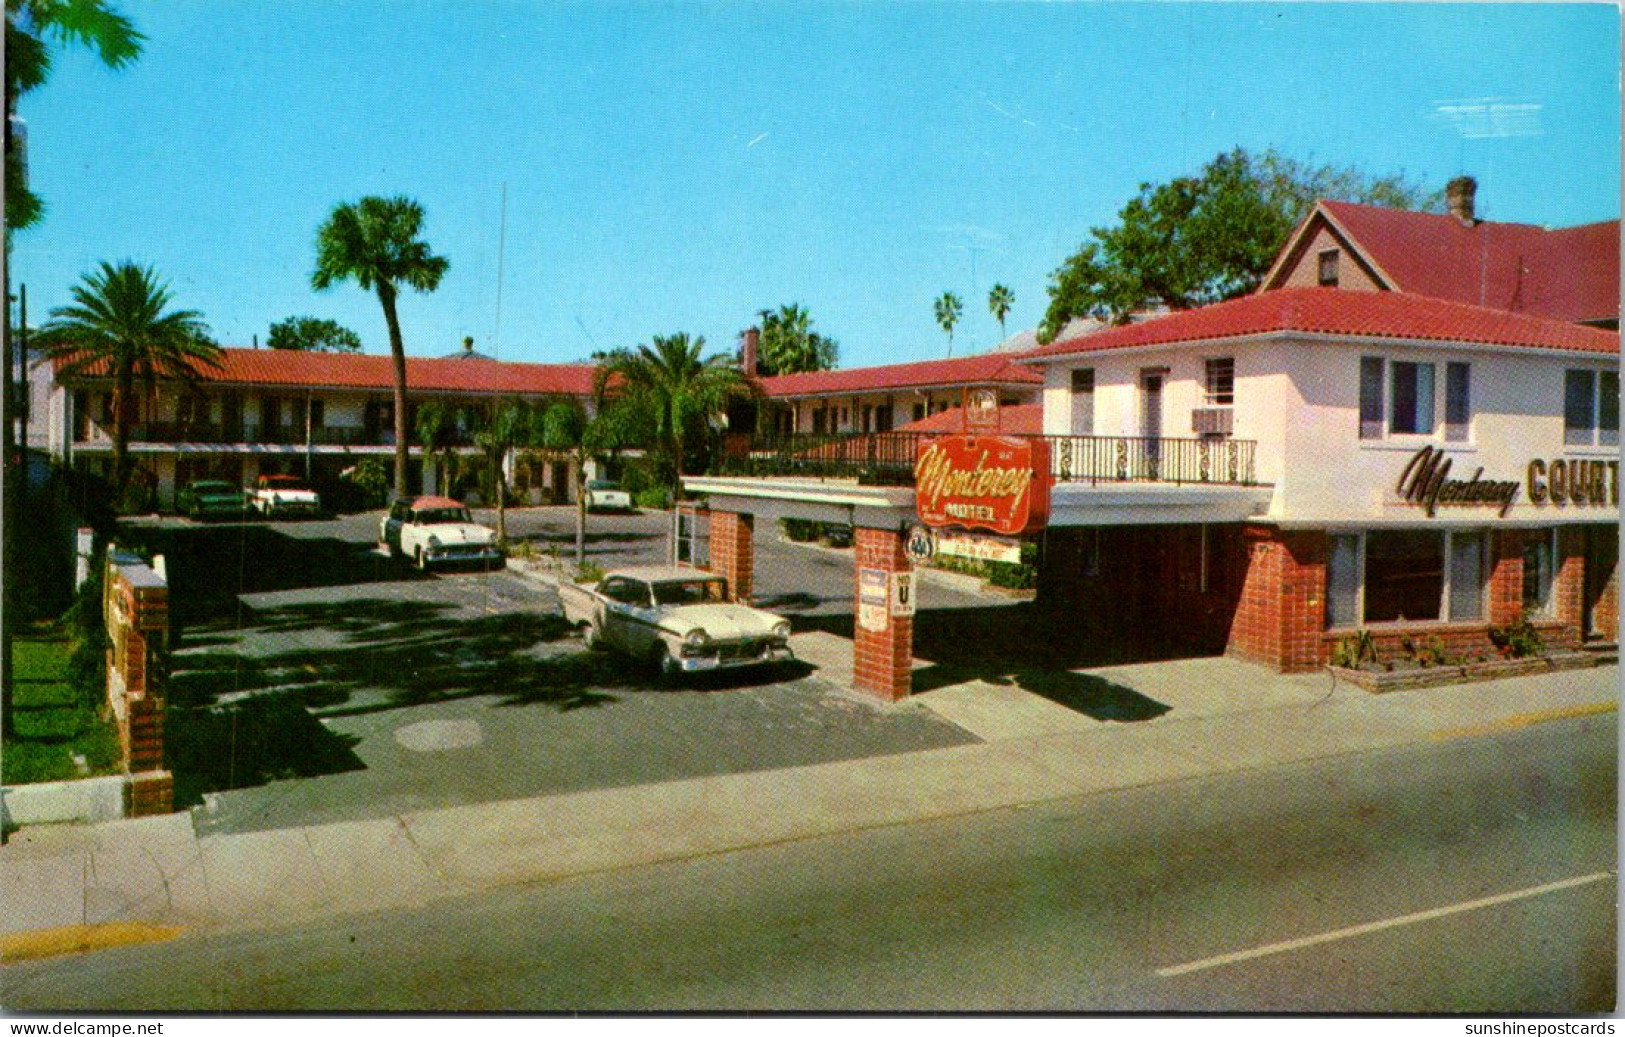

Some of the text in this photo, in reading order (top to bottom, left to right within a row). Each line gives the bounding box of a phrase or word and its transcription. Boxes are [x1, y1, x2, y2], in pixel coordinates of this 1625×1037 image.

[914, 443, 1033, 518] Monterey
[1395, 444, 1620, 518] Monterey COURT
[945, 503, 996, 522] MOTEL
[899, 585, 909, 605] U
